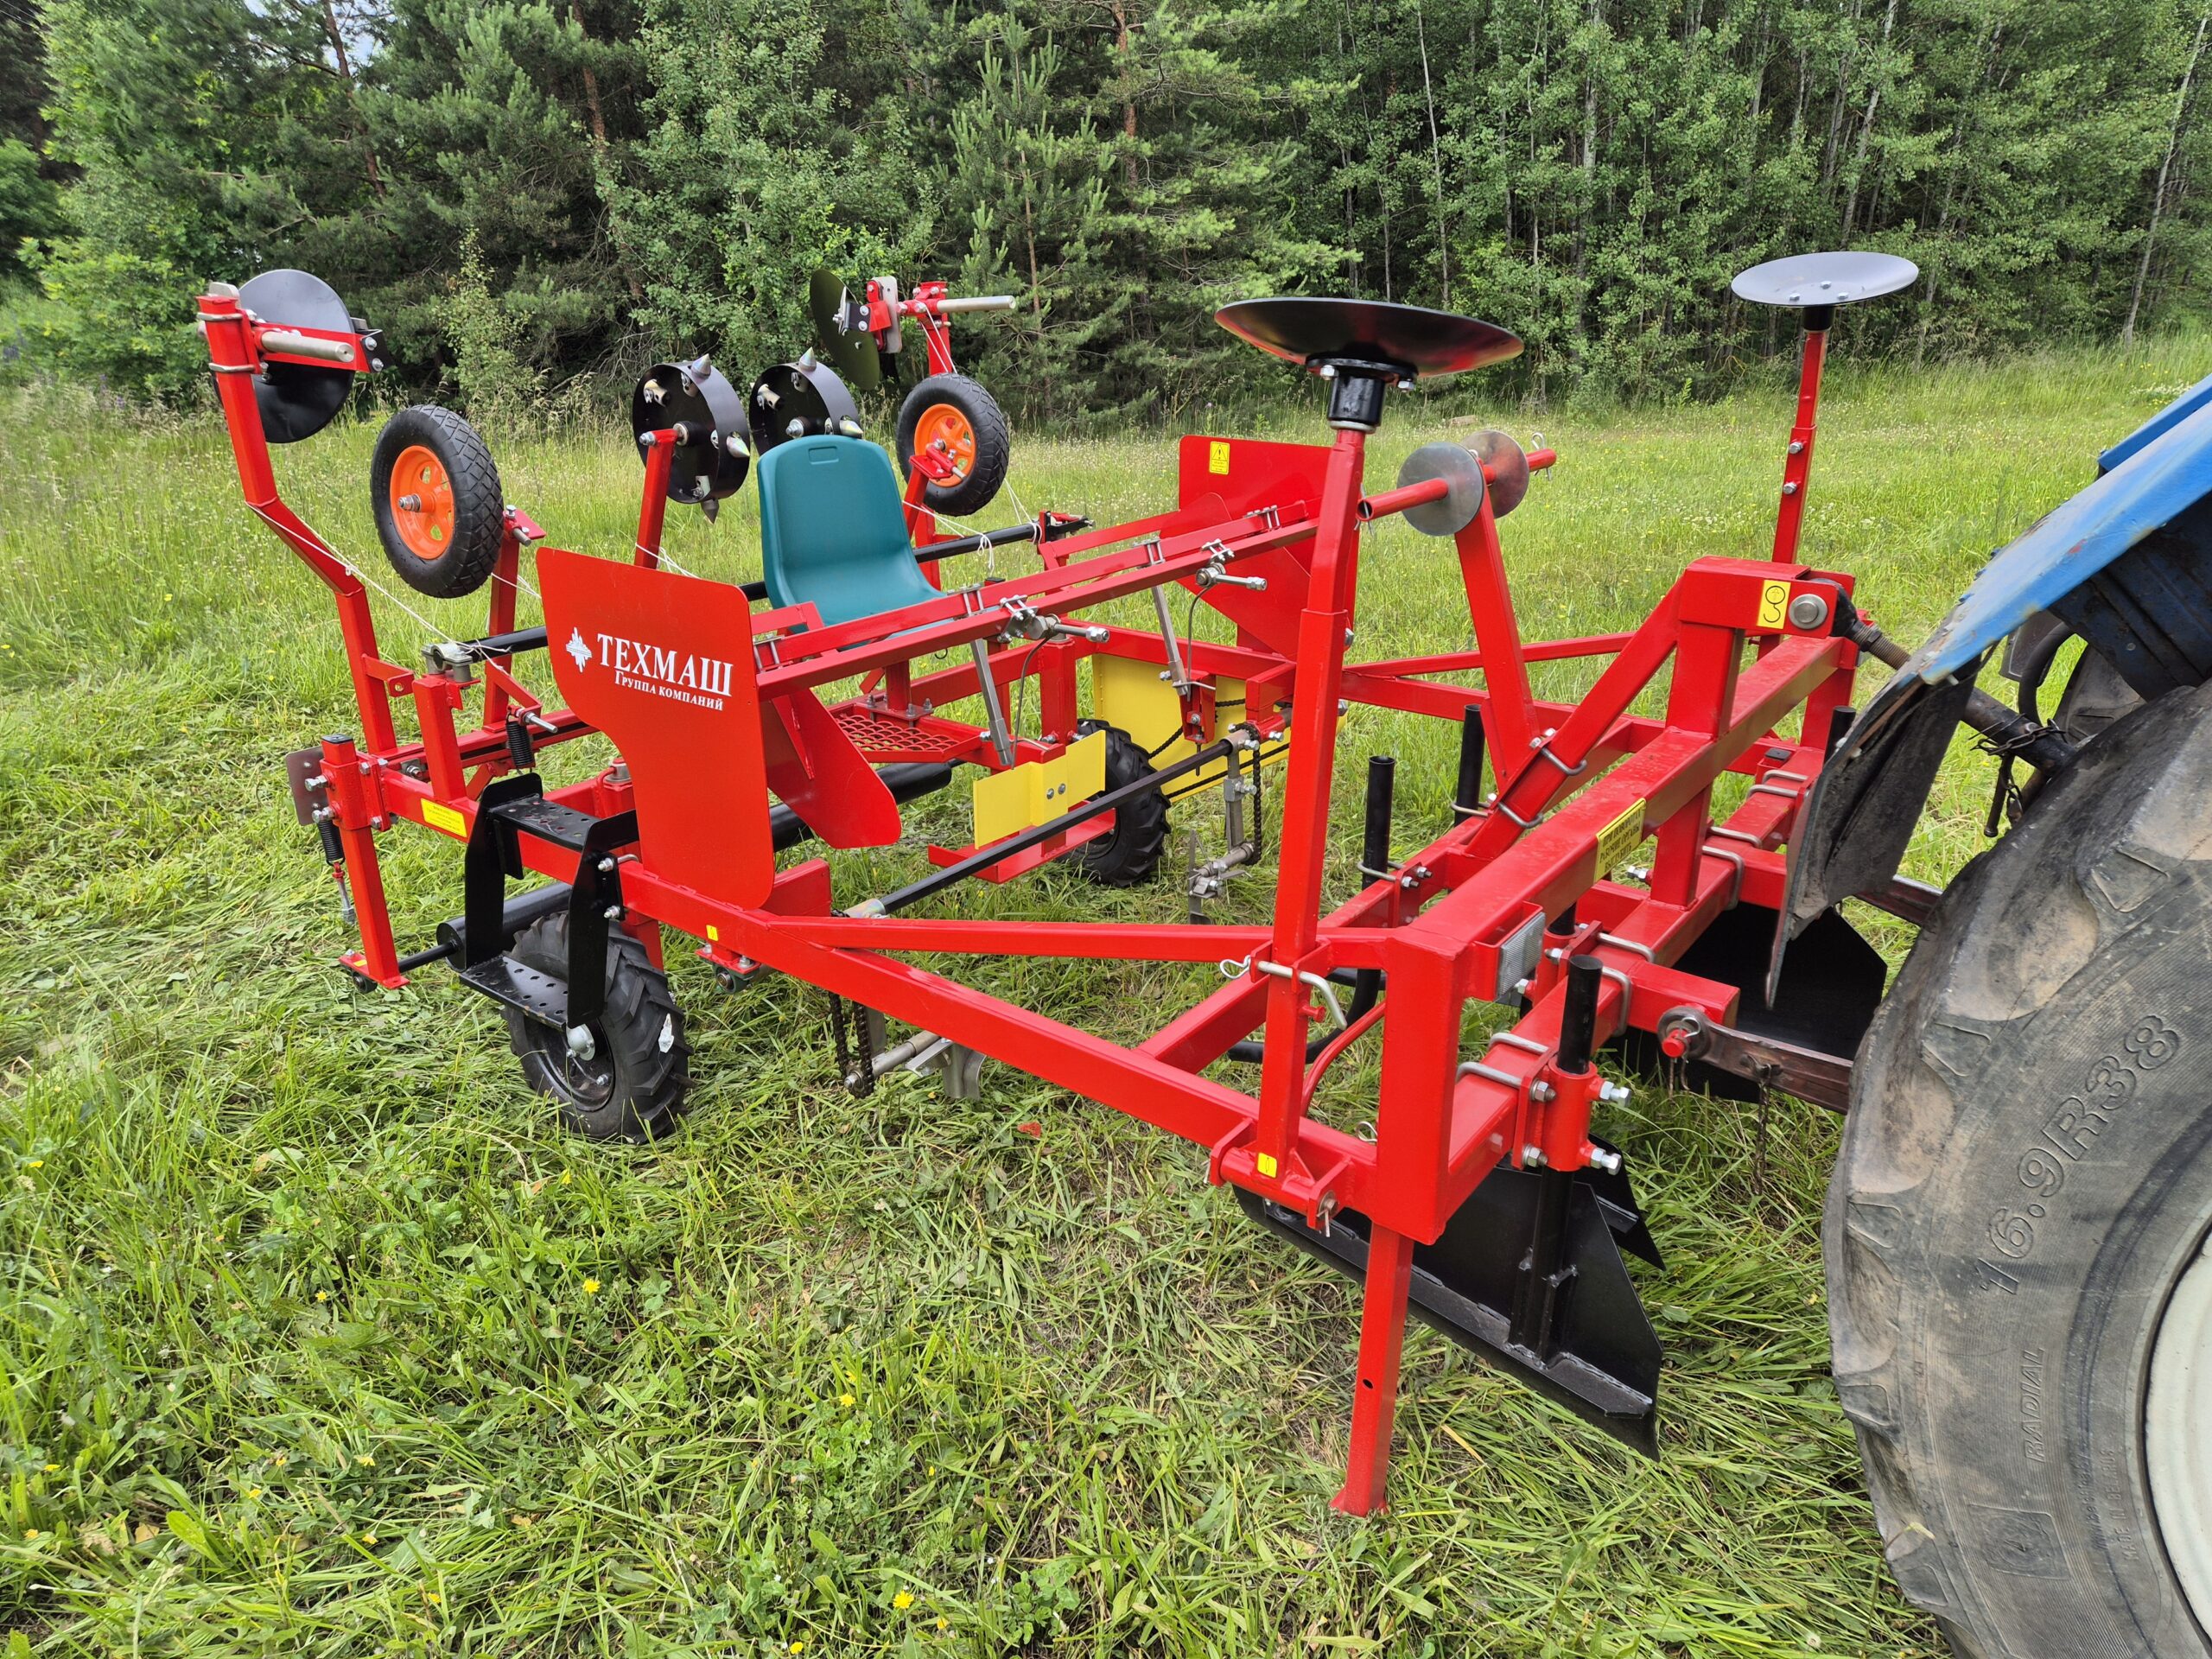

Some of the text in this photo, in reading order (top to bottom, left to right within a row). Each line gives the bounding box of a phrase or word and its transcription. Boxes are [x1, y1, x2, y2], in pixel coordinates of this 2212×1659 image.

[597, 633, 734, 697] ТЕХМАШ
[1974, 1014, 2180, 1295] 16.9R38
[2020, 1347, 2046, 1463] RADIAL
[2100, 1449, 2139, 1560] MADE IN BELARUS
